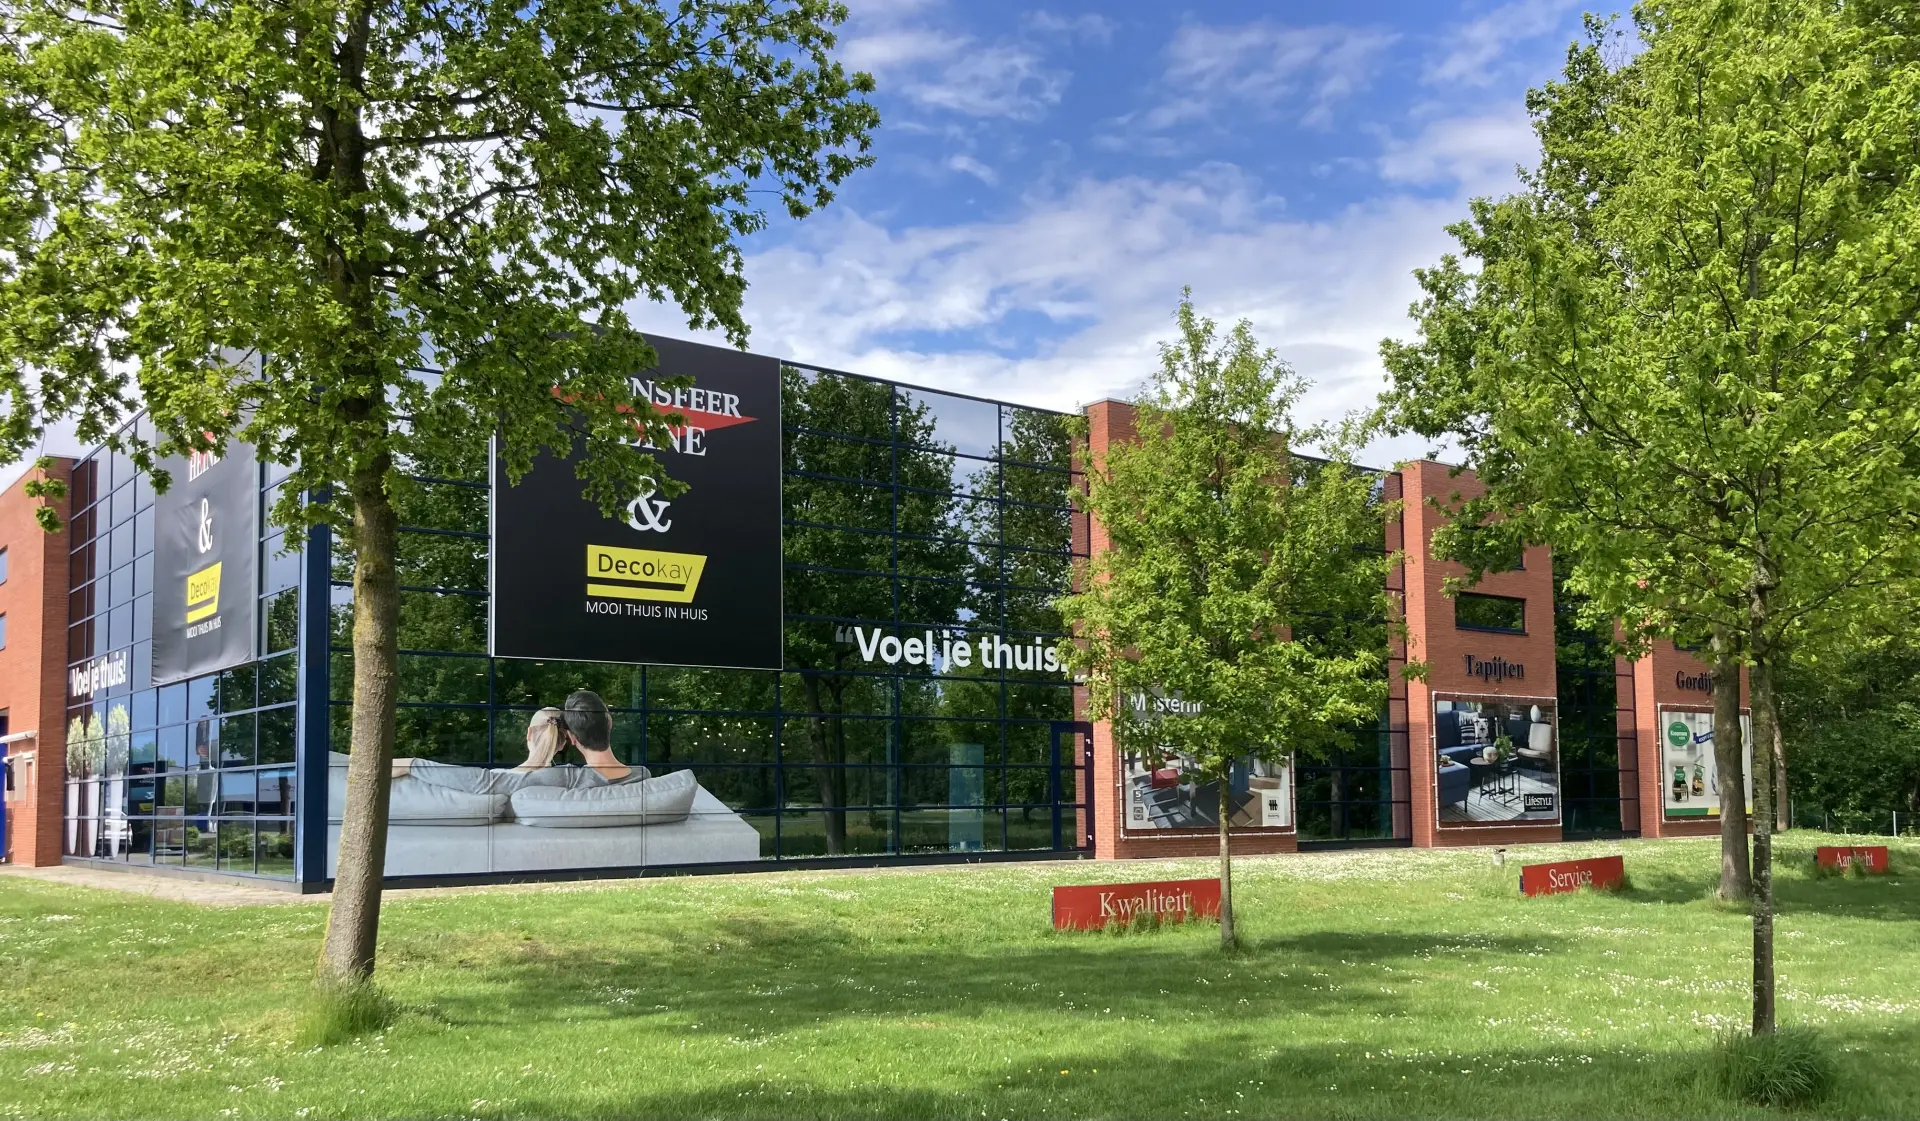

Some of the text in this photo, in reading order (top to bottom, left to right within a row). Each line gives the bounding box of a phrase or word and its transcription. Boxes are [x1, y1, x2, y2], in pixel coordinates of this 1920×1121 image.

[626, 475, 672, 533] &
[199, 498, 213, 553] &
[598, 553, 693, 583] Decokay
[586, 600, 708, 621] MOOI THUIS IN HUIS
[941, 629, 972, 674] je
[91, 660, 99, 699] je
[100, 651, 127, 689] thuis!
[1463, 654, 1525, 683] Tapijten
[1675, 670, 1714, 696] Gordij
[1549, 865, 1593, 889] Service
[1099, 887, 1190, 917] Kwaliteit
